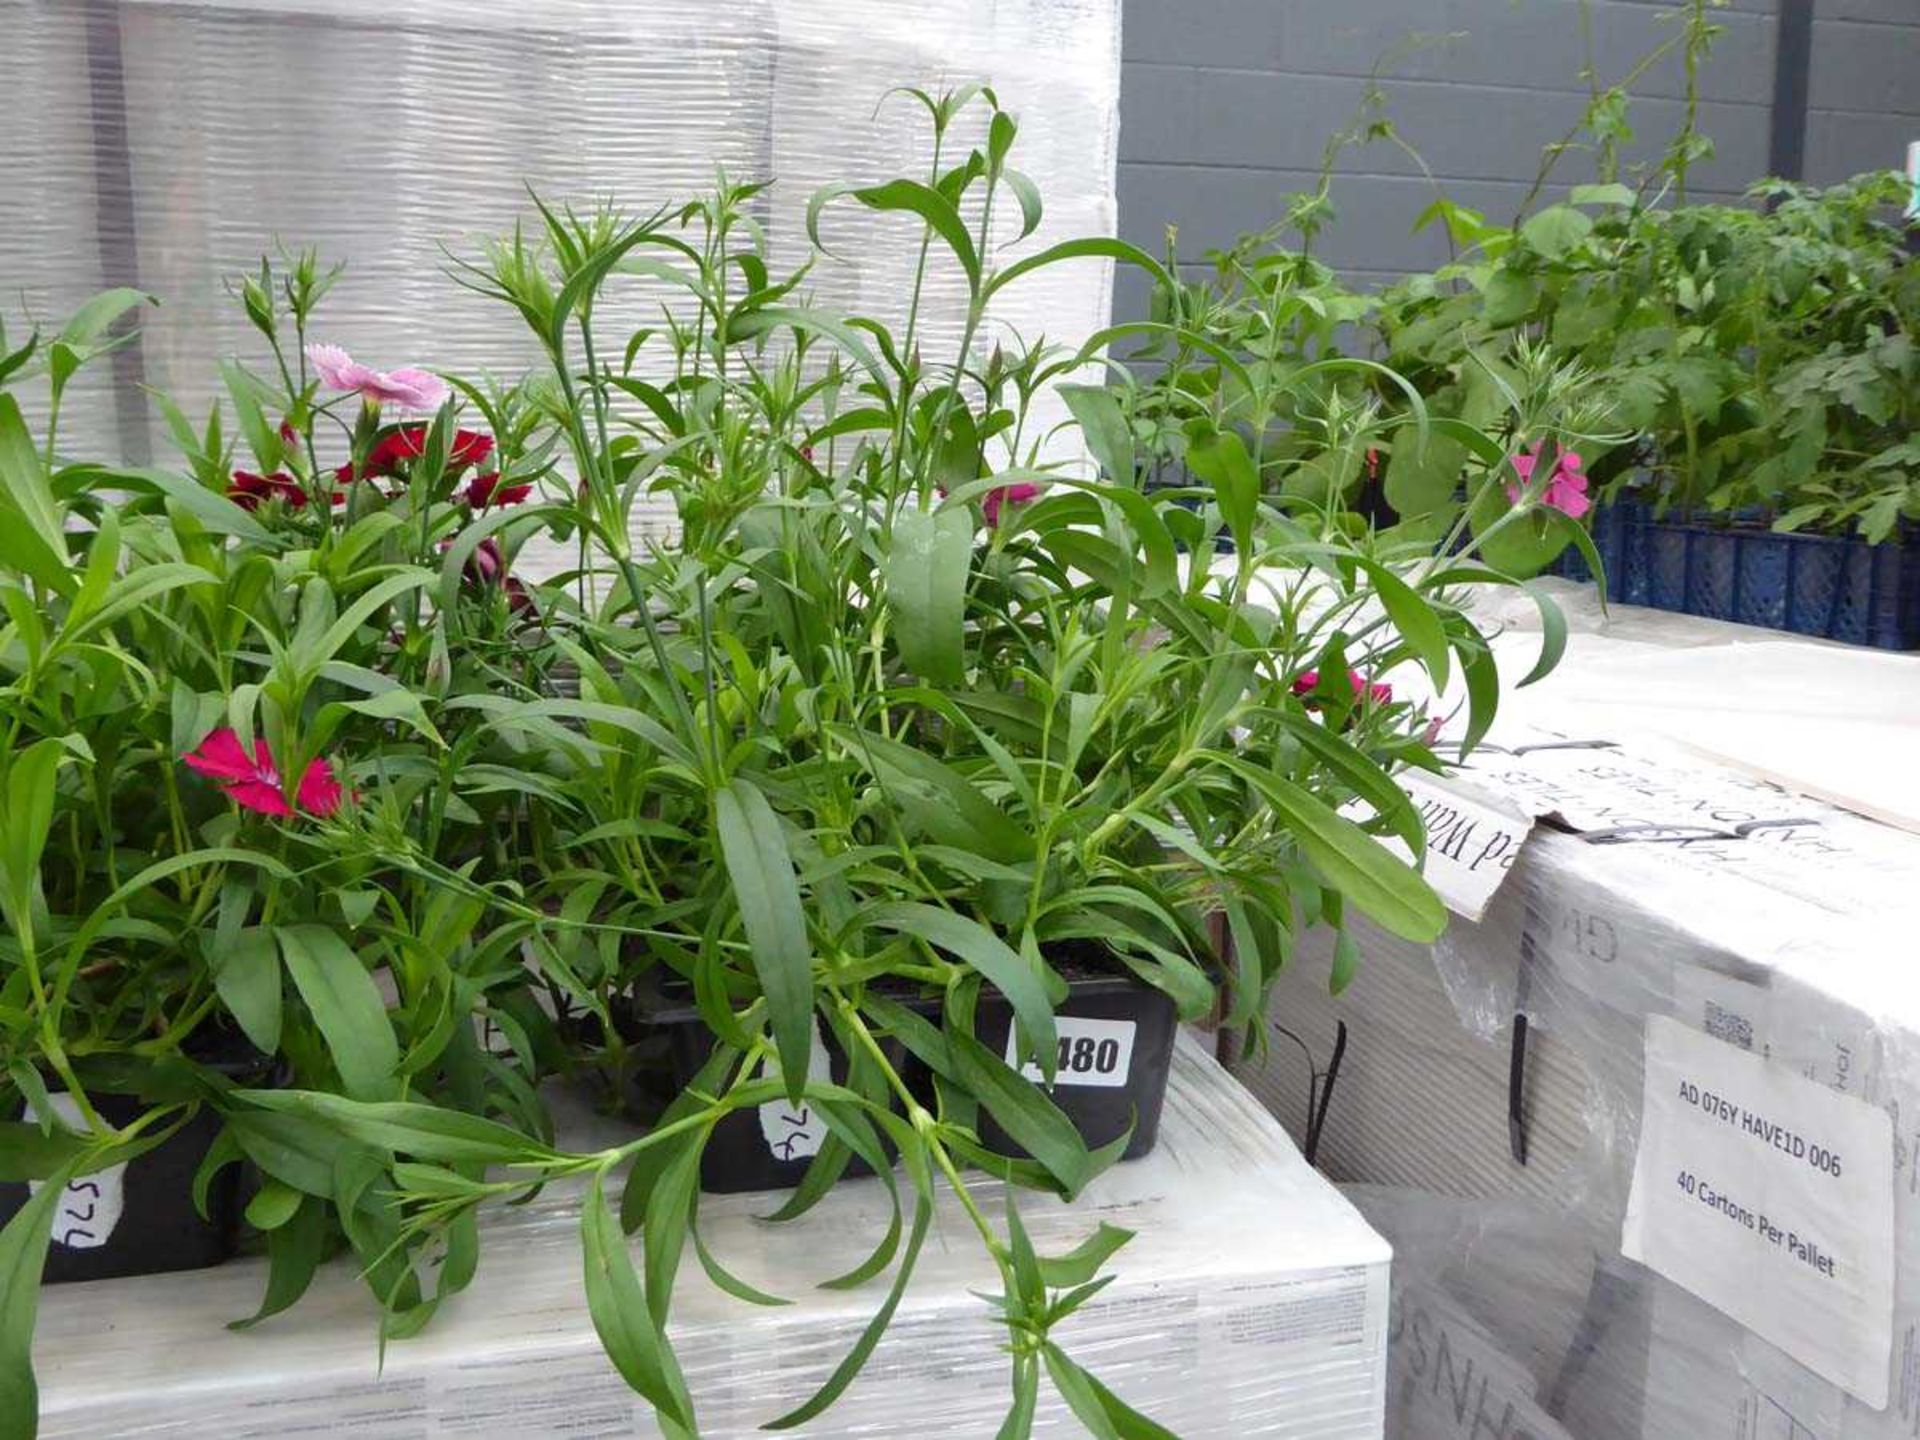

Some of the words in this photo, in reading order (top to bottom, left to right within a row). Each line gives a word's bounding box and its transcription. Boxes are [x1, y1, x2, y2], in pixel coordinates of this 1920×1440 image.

[1679, 1081, 1699, 1105] AD
[1702, 1091, 1738, 1125] 076Y
[1809, 1145, 1841, 1177] 006
[1677, 1171, 1695, 1194] 40
[1698, 1182, 1754, 1229] Cartons
[1759, 1215, 1784, 1246] Per
[1788, 1233, 1835, 1277] Pallet
